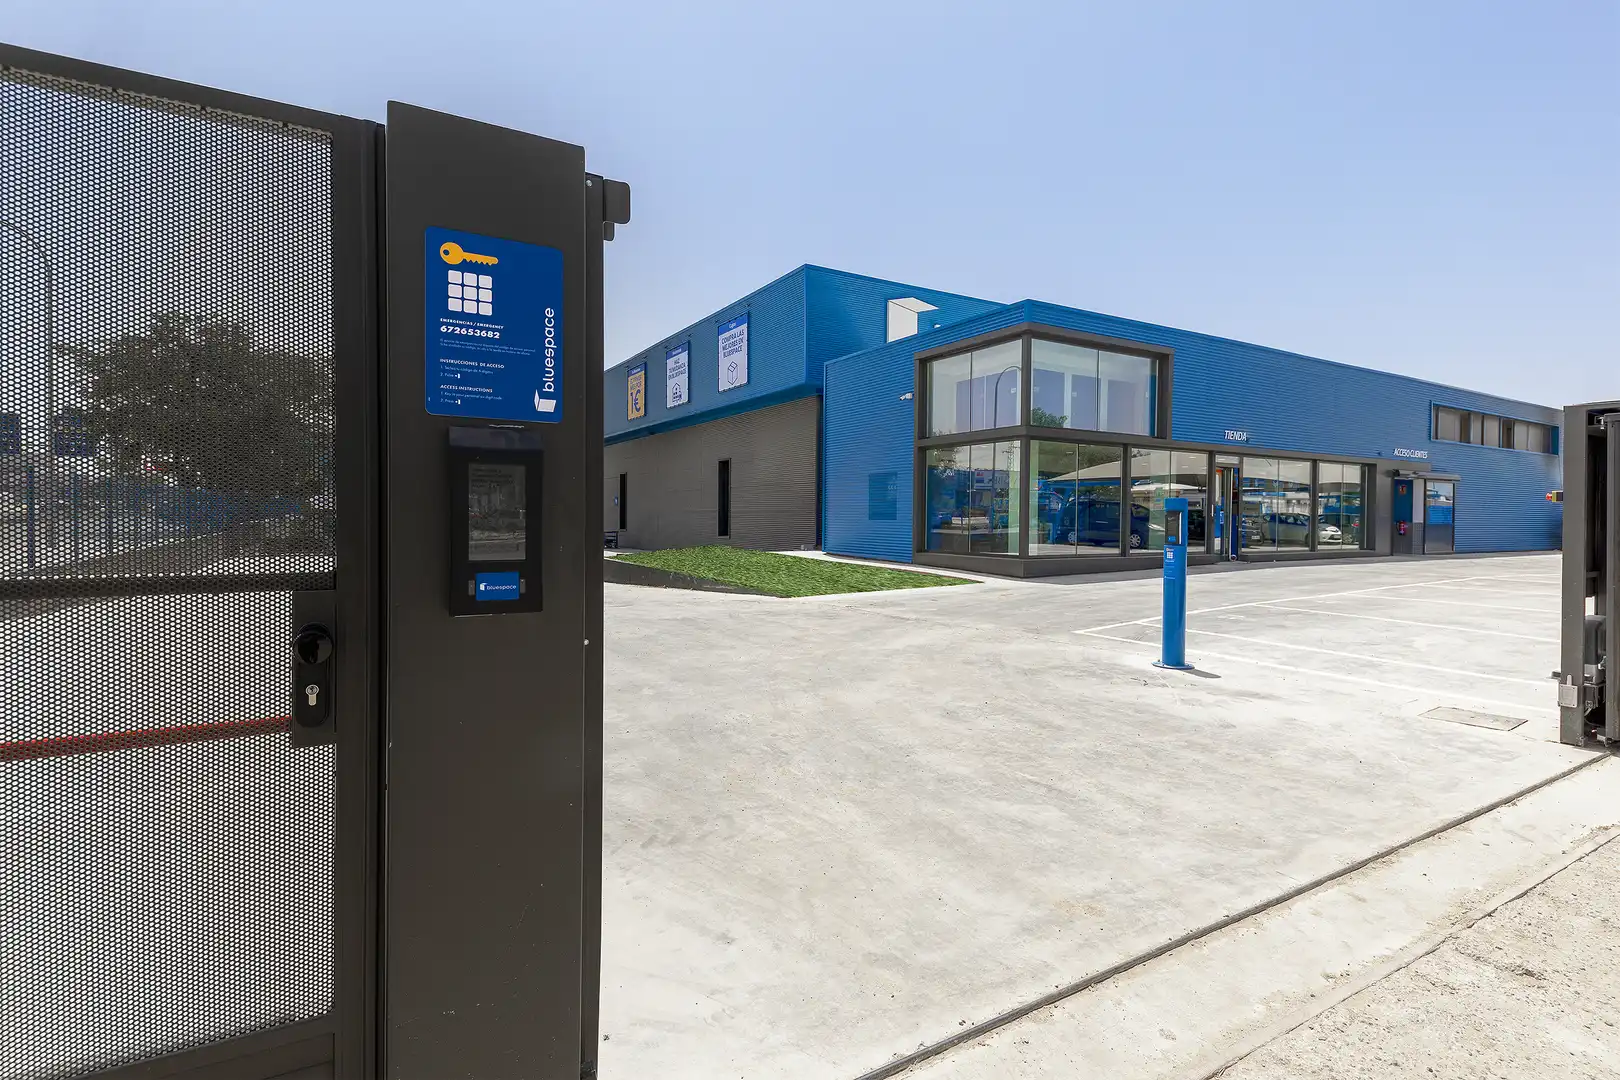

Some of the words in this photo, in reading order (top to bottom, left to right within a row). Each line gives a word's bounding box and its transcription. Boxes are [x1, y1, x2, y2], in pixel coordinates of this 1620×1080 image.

[440, 317, 473, 326] EMERGENCIAS
[440, 325, 500, 339] 672653682
[736, 328, 744, 338] LAS
[542, 307, 557, 392] bluespace
[630, 388, 642, 414] 1€
[1224, 430, 1247, 442] TIENDA
[1393, 448, 1410, 458] ACCESO
[1410, 450, 1428, 459] CLIENTES
